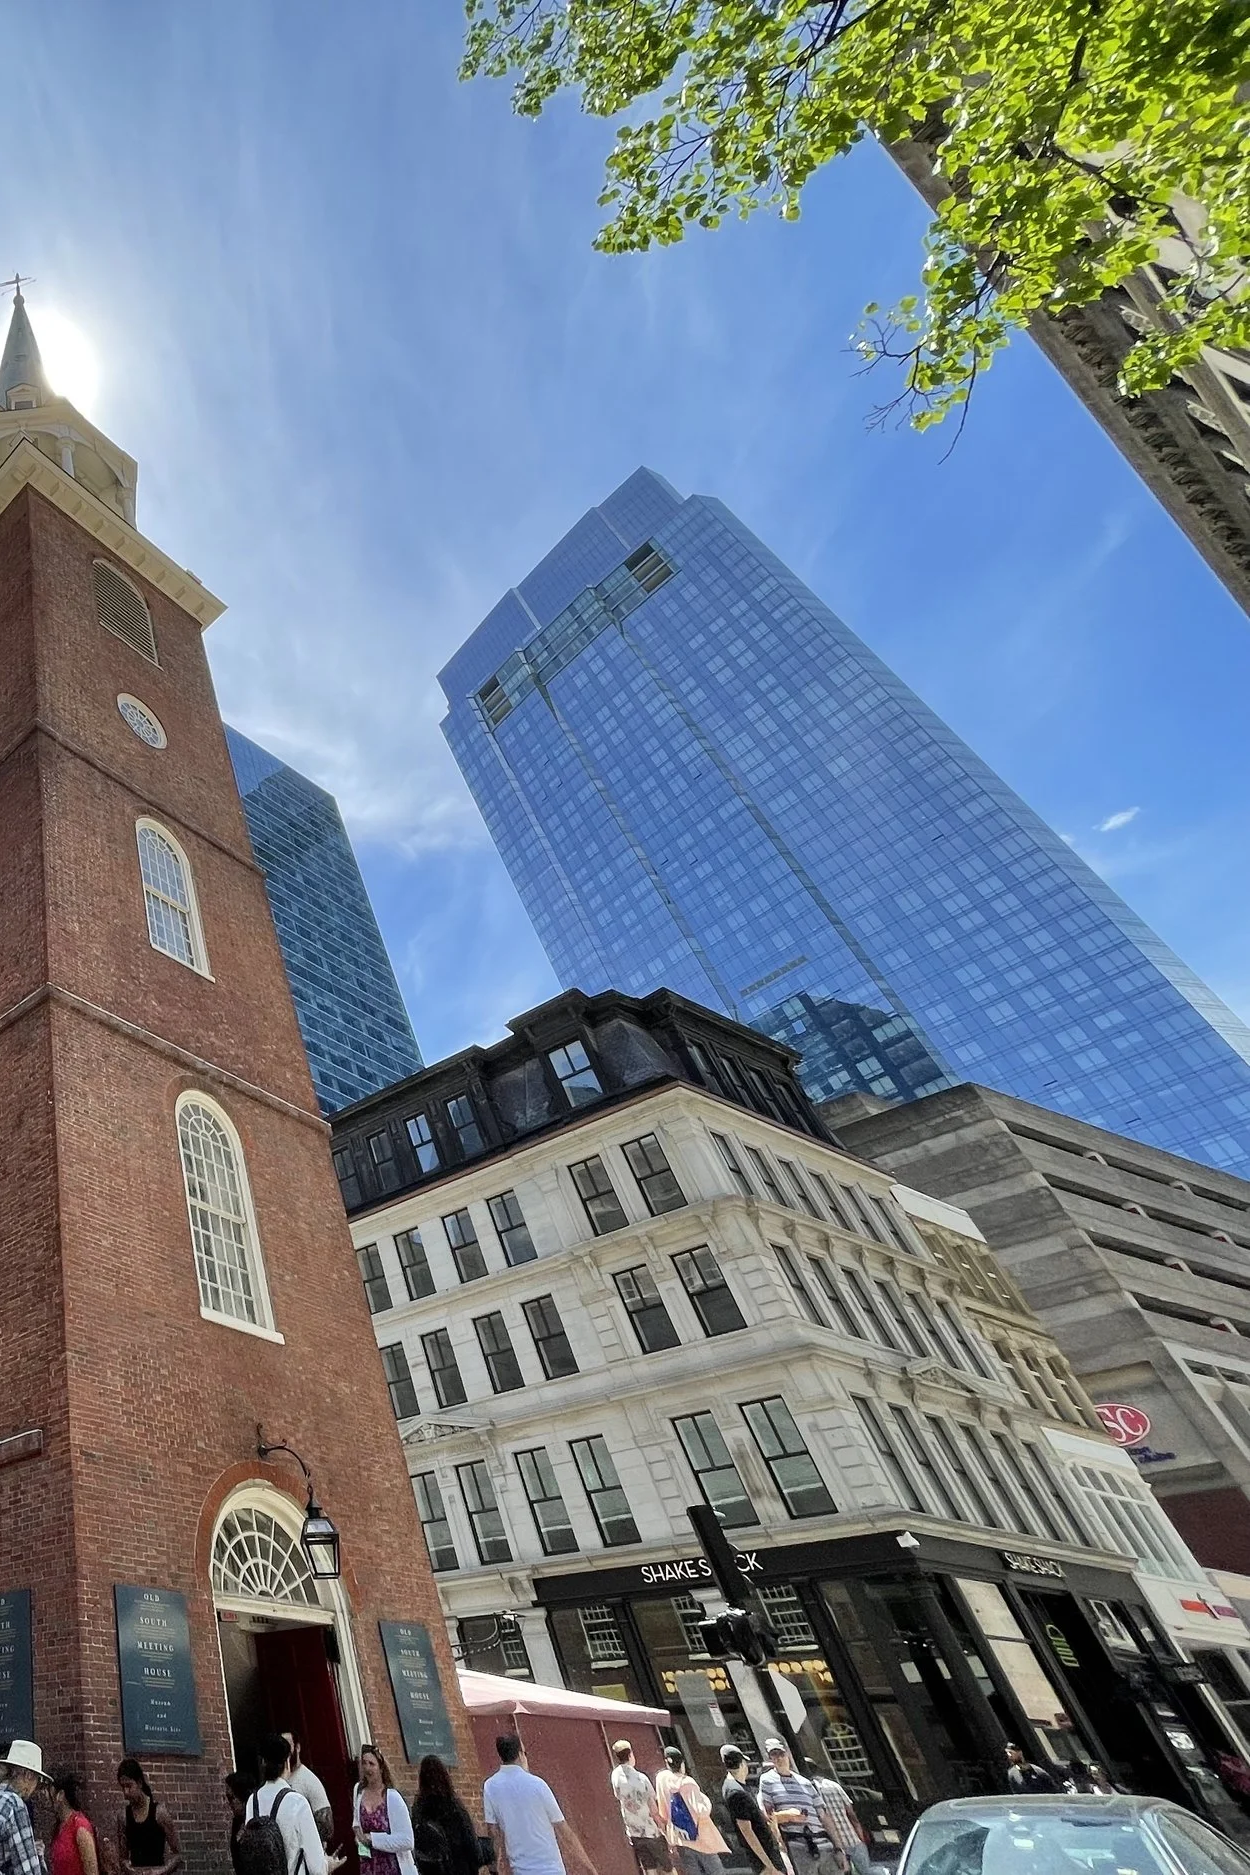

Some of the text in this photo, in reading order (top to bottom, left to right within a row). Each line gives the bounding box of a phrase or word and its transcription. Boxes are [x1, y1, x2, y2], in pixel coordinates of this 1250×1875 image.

[1093, 1408, 1143, 1442] SC
[641, 1552, 764, 1583] SHAKE SCK
[143, 1593, 161, 1602] OLD
[139, 1616, 168, 1628] SOUTH
[137, 1640, 175, 1652] MEETING
[143, 1667, 172, 1678] HOUSE
